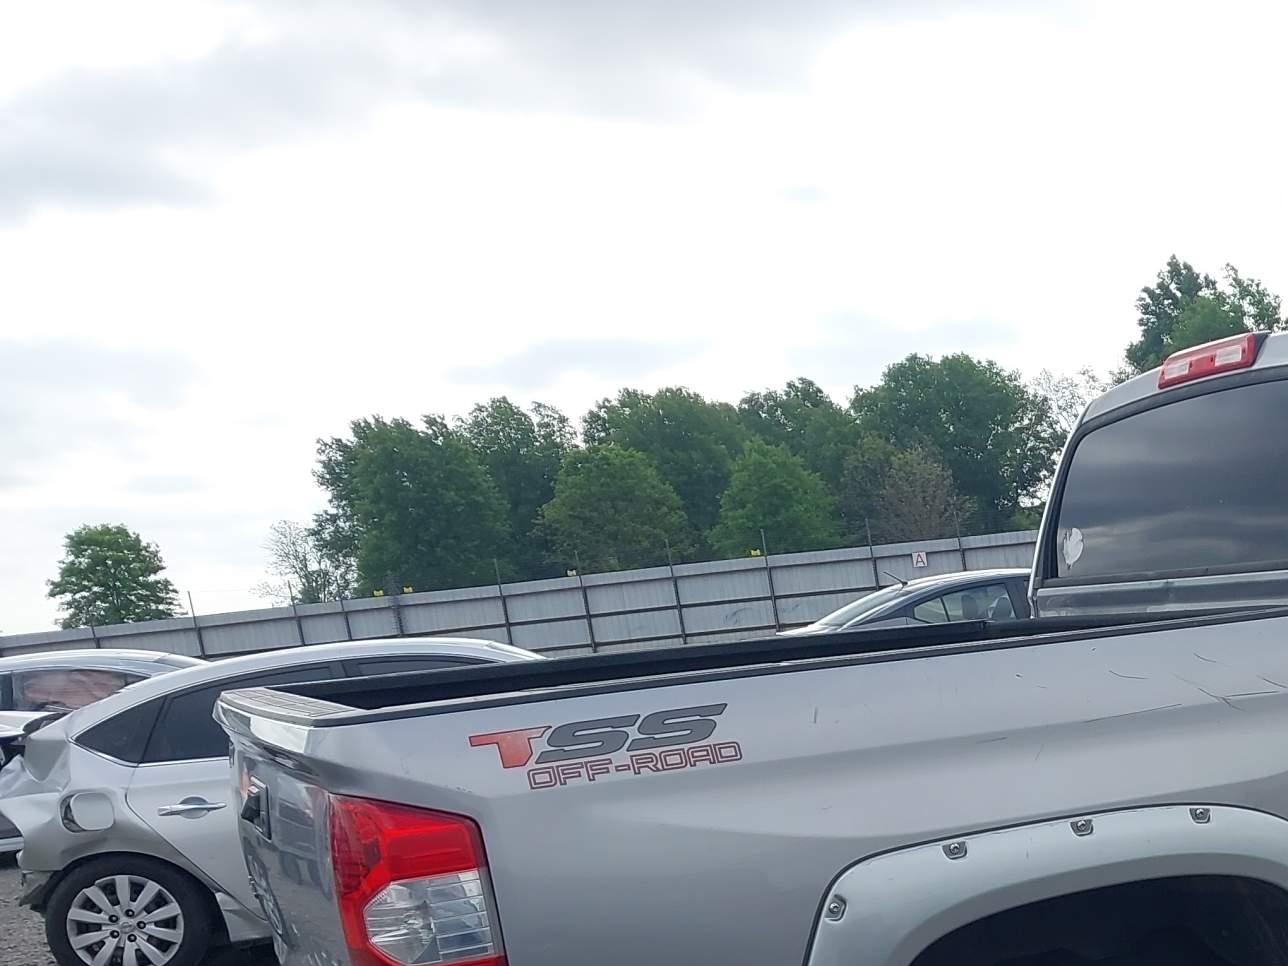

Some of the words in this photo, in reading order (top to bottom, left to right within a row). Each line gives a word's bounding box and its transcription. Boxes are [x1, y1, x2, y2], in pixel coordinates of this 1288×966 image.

[915, 553, 926, 566] A
[468, 703, 727, 768] TSS
[527, 741, 743, 790] OFF-ROAD
